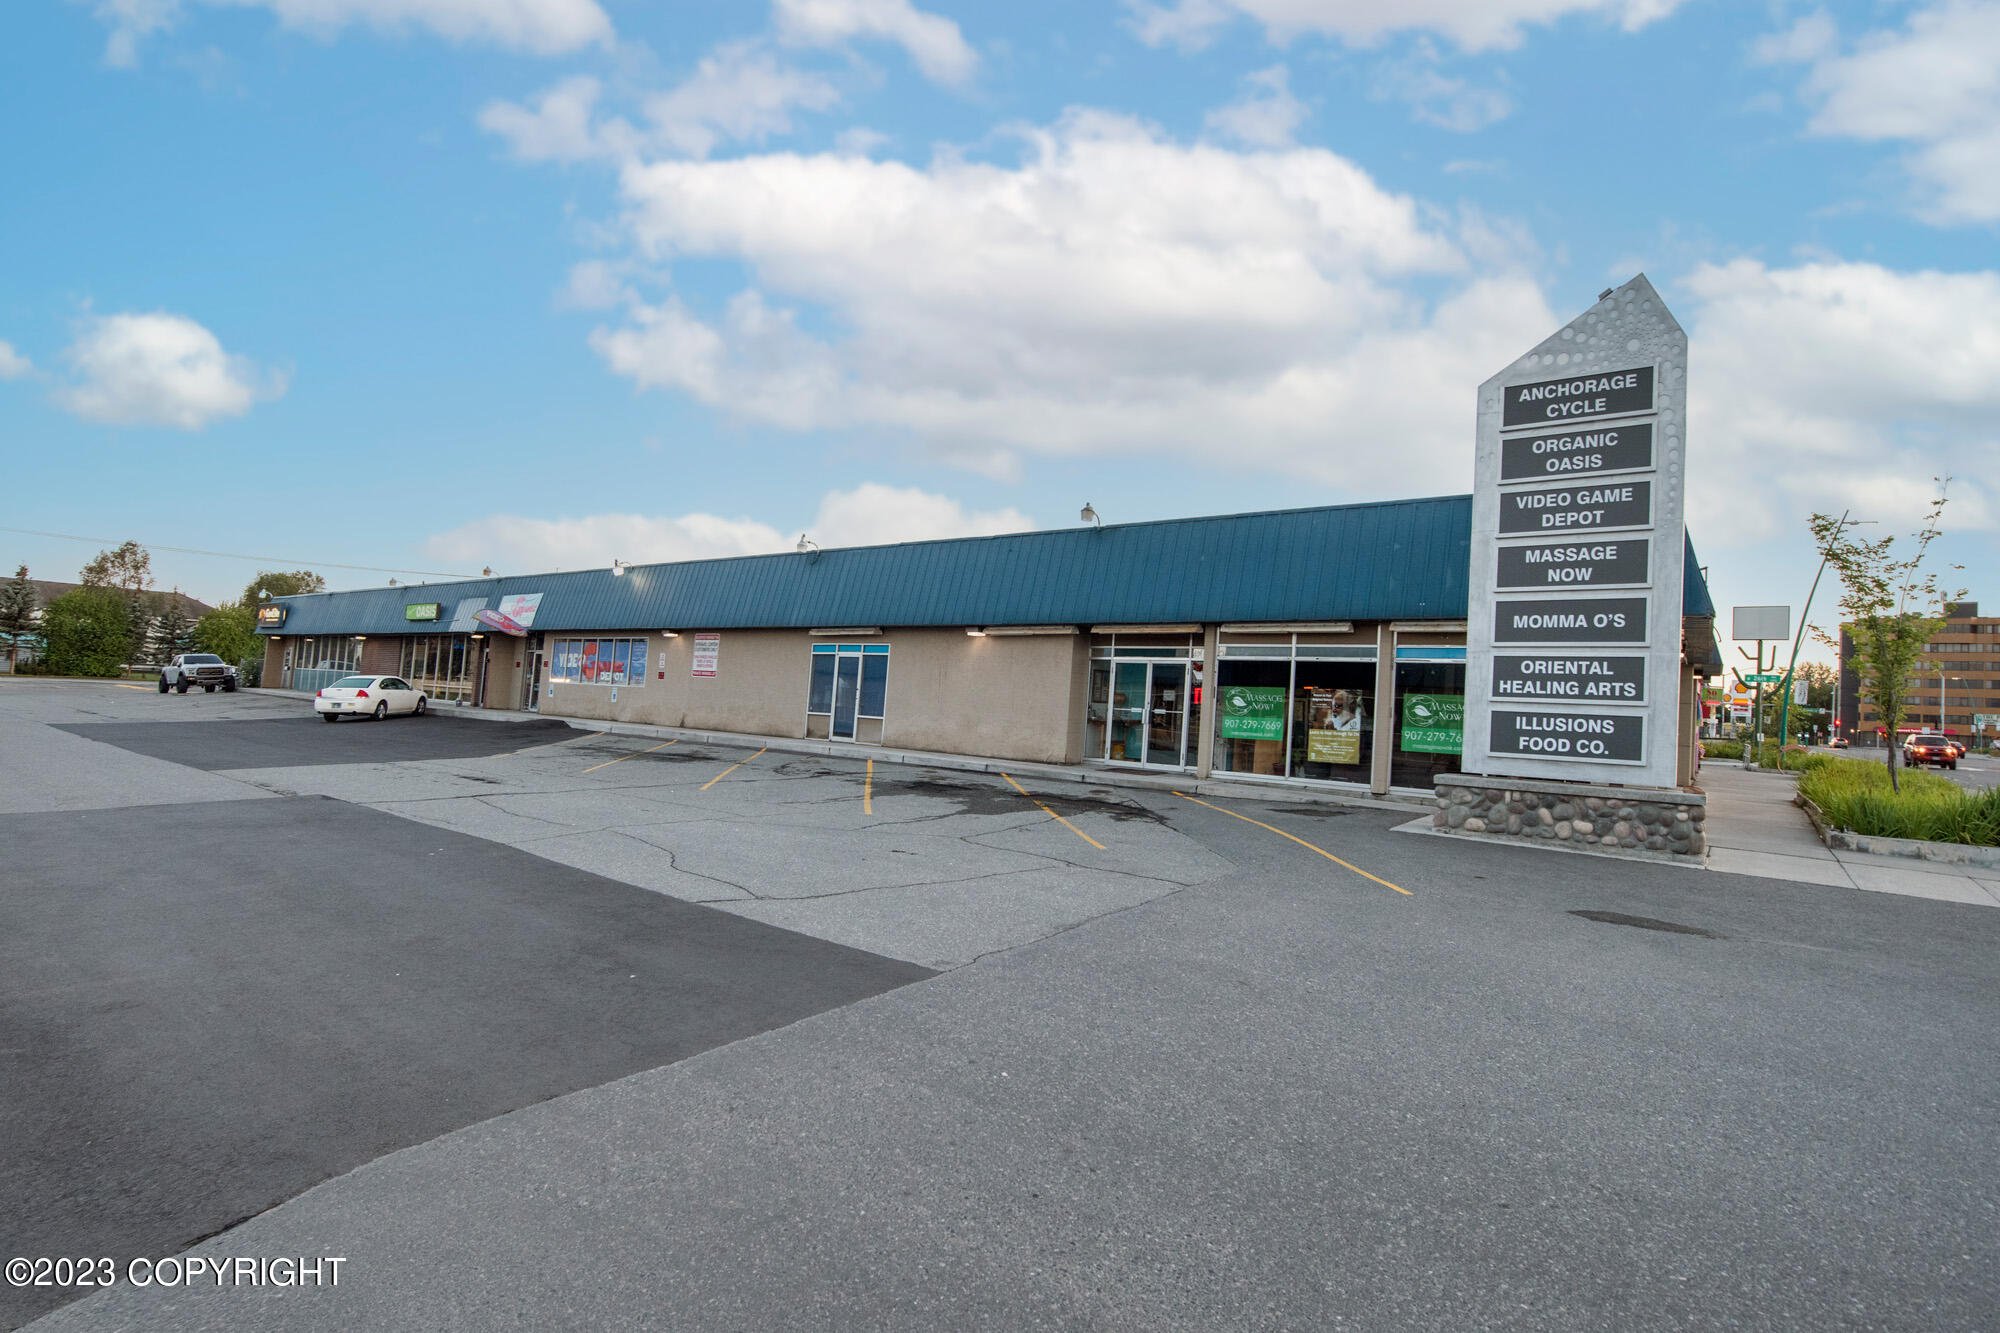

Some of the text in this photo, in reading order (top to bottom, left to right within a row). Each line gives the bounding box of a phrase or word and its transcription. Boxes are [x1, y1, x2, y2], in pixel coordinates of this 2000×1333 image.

[1519, 373, 1638, 402] ANCHORAGE
[1546, 398, 1607, 418] CYCLE
[1532, 432, 1619, 454] ORGANIC
[1545, 454, 1603, 472] OASIS
[1516, 487, 1633, 509] VIDEO GAME
[1541, 510, 1605, 527] DEPOT
[1525, 546, 1618, 563] MASSAGE
[1547, 567, 1593, 582] NOW
[416, 605, 437, 617] OASIS
[1513, 613, 1626, 629] MOMMA O'S
[1520, 660, 1614, 675] ORIENTAL
[1499, 680, 1637, 697] HEALING ARTS
[1246, 693, 1283, 704] MASSAGE
[1251, 702, 1275, 711] NOW!
[1430, 702, 1464, 711] MASSA
[1225, 719, 1282, 730] 907-279-7669
[1515, 716, 1615, 734] ILLUSIONS
[1518, 736, 1610, 755] FOOD CO.
